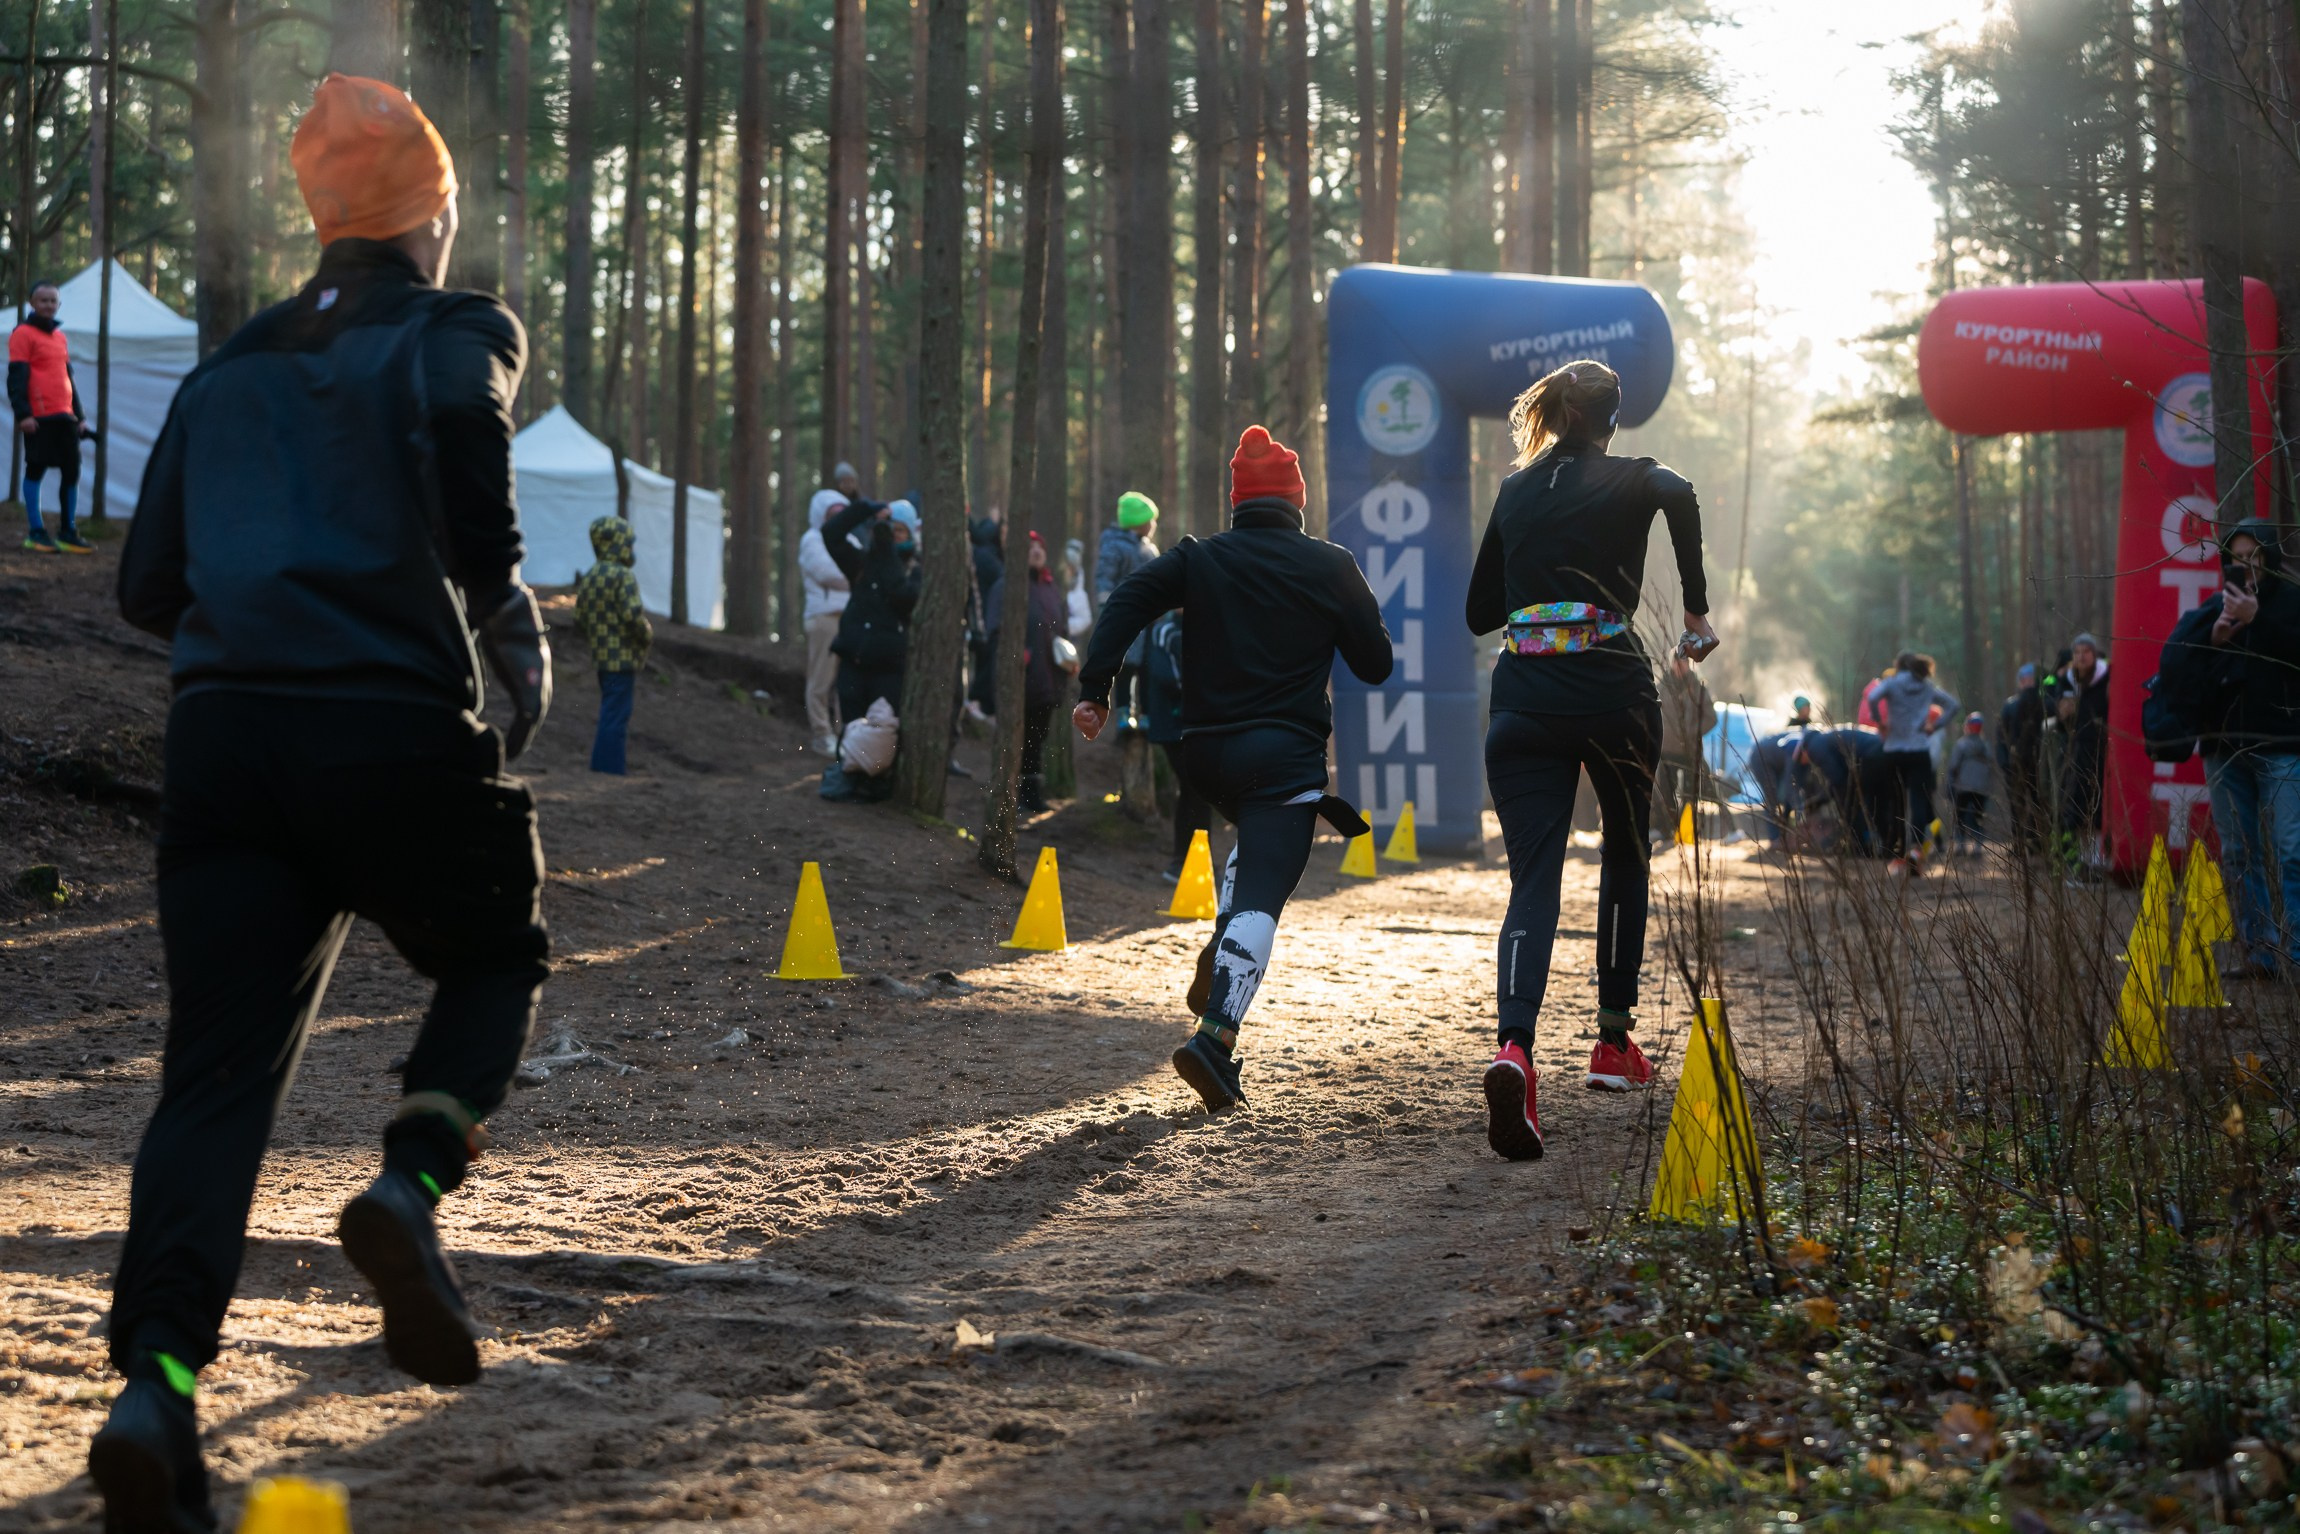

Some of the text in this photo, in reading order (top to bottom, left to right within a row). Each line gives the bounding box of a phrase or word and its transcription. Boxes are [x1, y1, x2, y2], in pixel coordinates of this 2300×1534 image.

[1490, 319, 1634, 361] КУРОРТНЫЙ
[1954, 319, 2103, 352] КУРОРТНЫЙ
[1986, 345, 2069, 372] РАЙОН
[2150, 495, 2221, 849] СТТ
